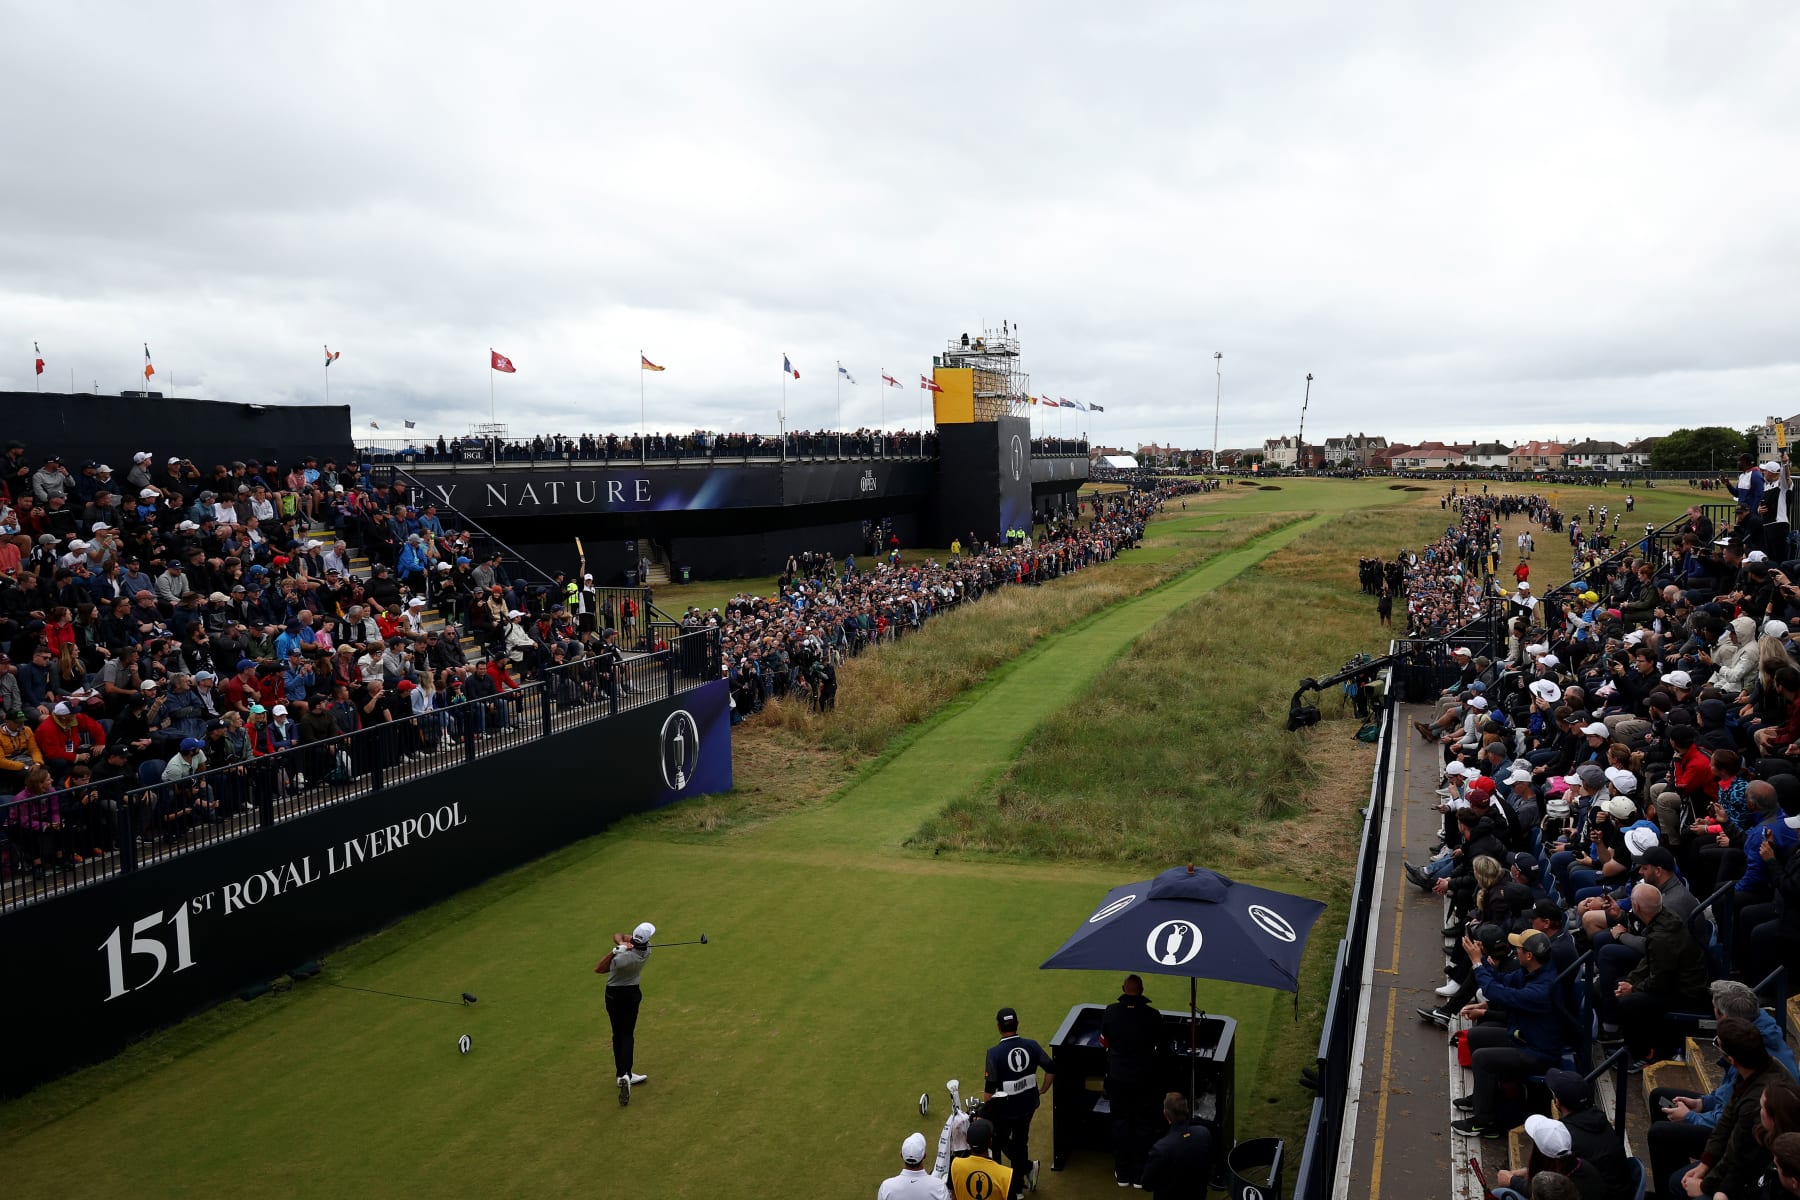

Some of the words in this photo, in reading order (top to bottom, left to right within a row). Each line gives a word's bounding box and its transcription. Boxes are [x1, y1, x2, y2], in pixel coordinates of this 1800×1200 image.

[486, 479, 651, 507] NATURE
[222, 856, 321, 915] ROYAL
[327, 802, 467, 875] LIVERPOOL
